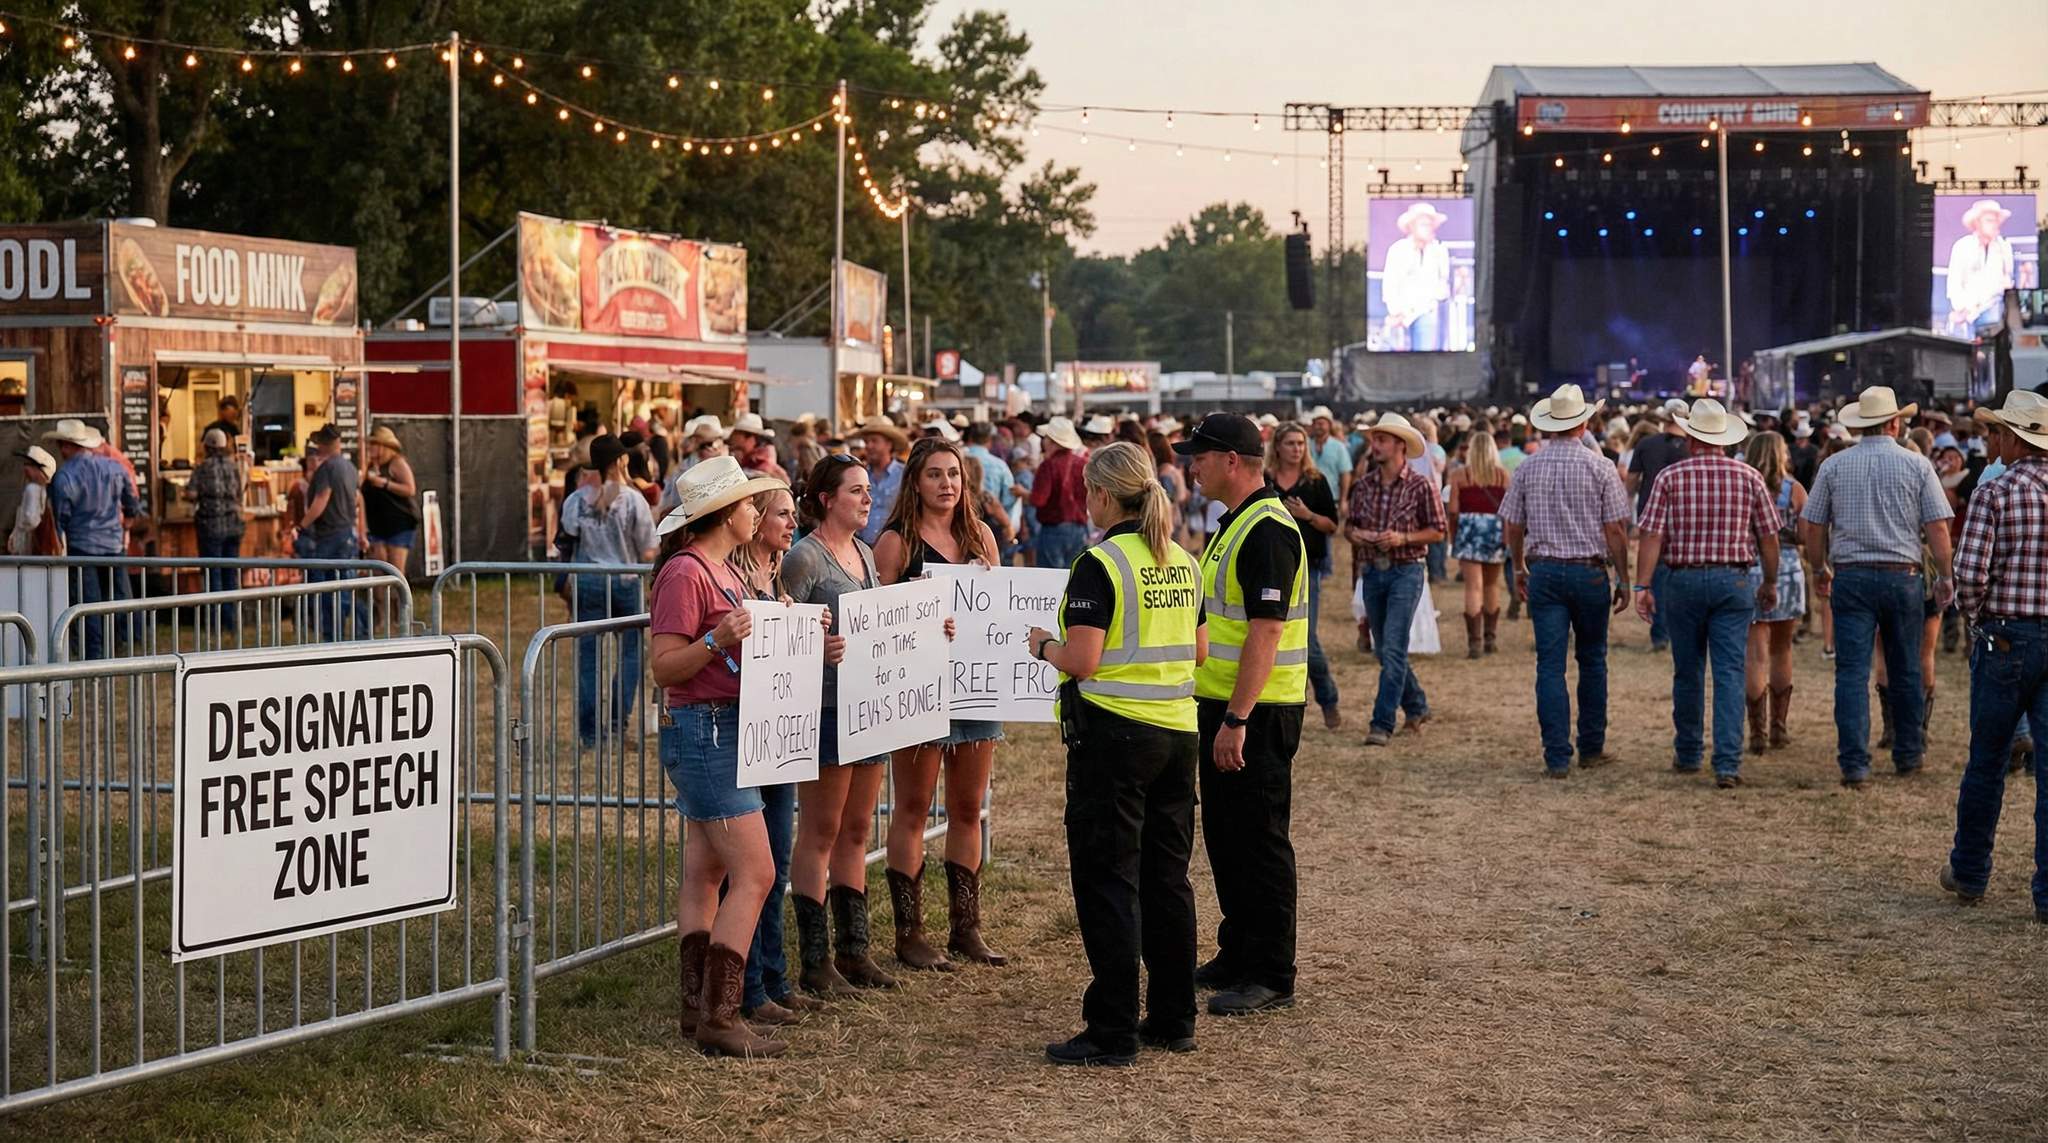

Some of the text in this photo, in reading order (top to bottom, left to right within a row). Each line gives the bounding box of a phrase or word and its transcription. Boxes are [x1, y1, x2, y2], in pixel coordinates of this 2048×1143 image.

[1658, 103, 1747, 124] COUNTRY
[176, 244, 307, 311] FOOD MINK
[1140, 565, 1193, 585] SECURITY
[954, 579, 991, 612] No
[1144, 588, 1194, 609] SECURITY
[847, 603, 869, 635] We
[986, 623, 1013, 645] for
[753, 614, 781, 659] LET
[772, 672, 793, 701] FOR
[898, 667, 906, 679] a
[949, 660, 999, 695] REE
[208, 683, 434, 762] DESIGNATED
[743, 710, 818, 767] OUR SPEECH
[201, 750, 438, 838] FREE SPEECH
[273, 828, 370, 900] ZONE
